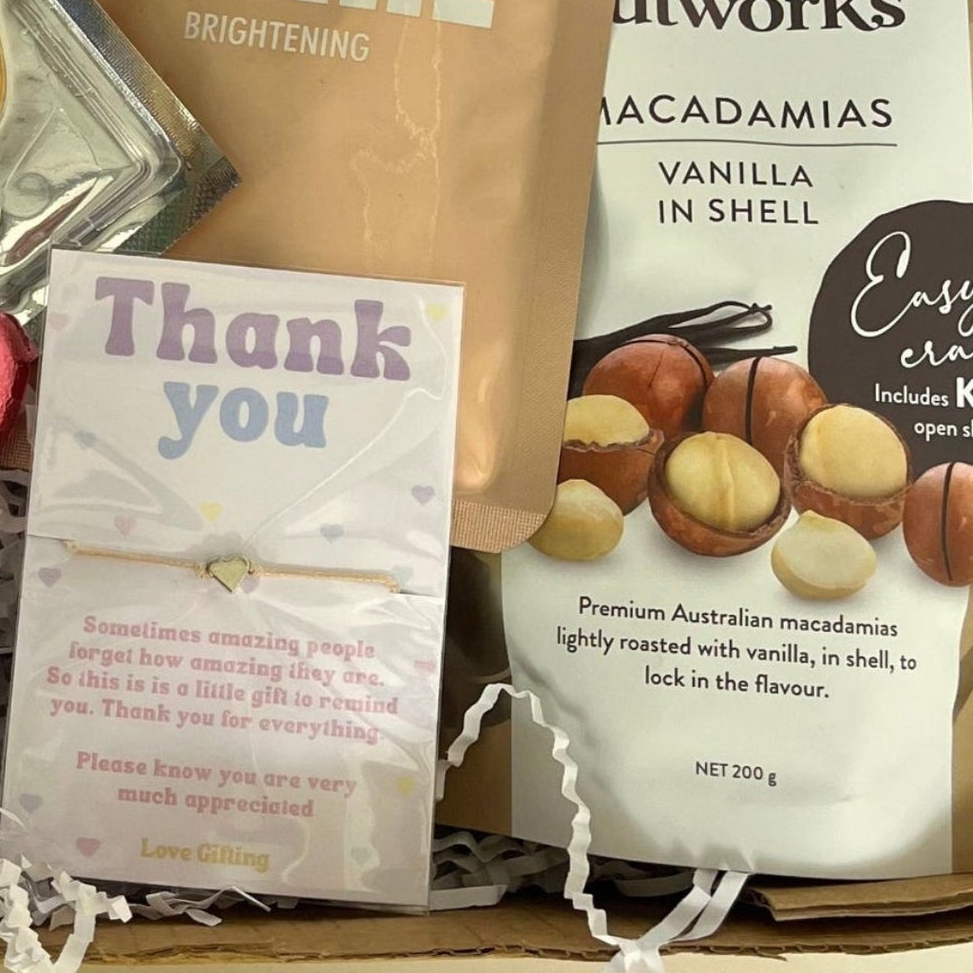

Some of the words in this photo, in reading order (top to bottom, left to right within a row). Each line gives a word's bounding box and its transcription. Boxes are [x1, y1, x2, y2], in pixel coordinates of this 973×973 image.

[183, 11, 371, 62] BRIGHTENING
[658, 161, 814, 188] VANILLA
[659, 199, 693, 223] IN
[709, 199, 819, 225] SHELL
[94, 276, 412, 381] Thank
[875, 383, 949, 407] Includes
[157, 380, 329, 461] you
[914, 422, 958, 442] open
[578, 596, 665, 622] Premium
[671, 603, 773, 629] Australian
[779, 614, 899, 638] macadamias
[83, 615, 202, 645] Sometimes
[208, 630, 300, 656] amazing
[306, 640, 376, 662] people
[556, 626, 615, 655] lightly
[619, 635, 692, 656] roasted
[697, 637, 740, 659] with
[746, 643, 816, 669] vanilla,
[822, 647, 840, 667] in
[845, 649, 895, 674] shell,
[899, 655, 917, 671] to
[68, 641, 133, 665] forget
[138, 648, 184, 668] how
[190, 656, 283, 682] amazing
[289, 661, 336, 687] they
[342, 671, 385, 687] are.
[644, 665, 686, 688] lock
[691, 669, 709, 690] in
[715, 671, 749, 693] the
[754, 673, 829, 699] flavour.
[47, 666, 73, 687] So
[78, 670, 120, 690] this
[126, 674, 145, 693] is
[152, 677, 170, 695] is
[177, 683, 189, 697] a
[195, 680, 245, 702] little
[251, 686, 288, 709] gift
[294, 691, 313, 708] to
[319, 696, 399, 715] remind
[49, 697, 94, 717] you.
[102, 698, 170, 723] Thank
[177, 710, 215, 728] you
[221, 711, 252, 729] for
[76, 751, 148, 776] Please
[153, 759, 213, 781] know
[218, 770, 257, 788] you
[264, 773, 301, 789] are
[307, 776, 357, 799] very
[695, 761, 728, 778] NET
[732, 764, 763, 781] 200
[767, 771, 777, 787] g
[118, 787, 178, 807] much
[185, 791, 315, 818] appreciated
[140, 837, 192, 863] Love
[197, 842, 270, 874] Gifting
